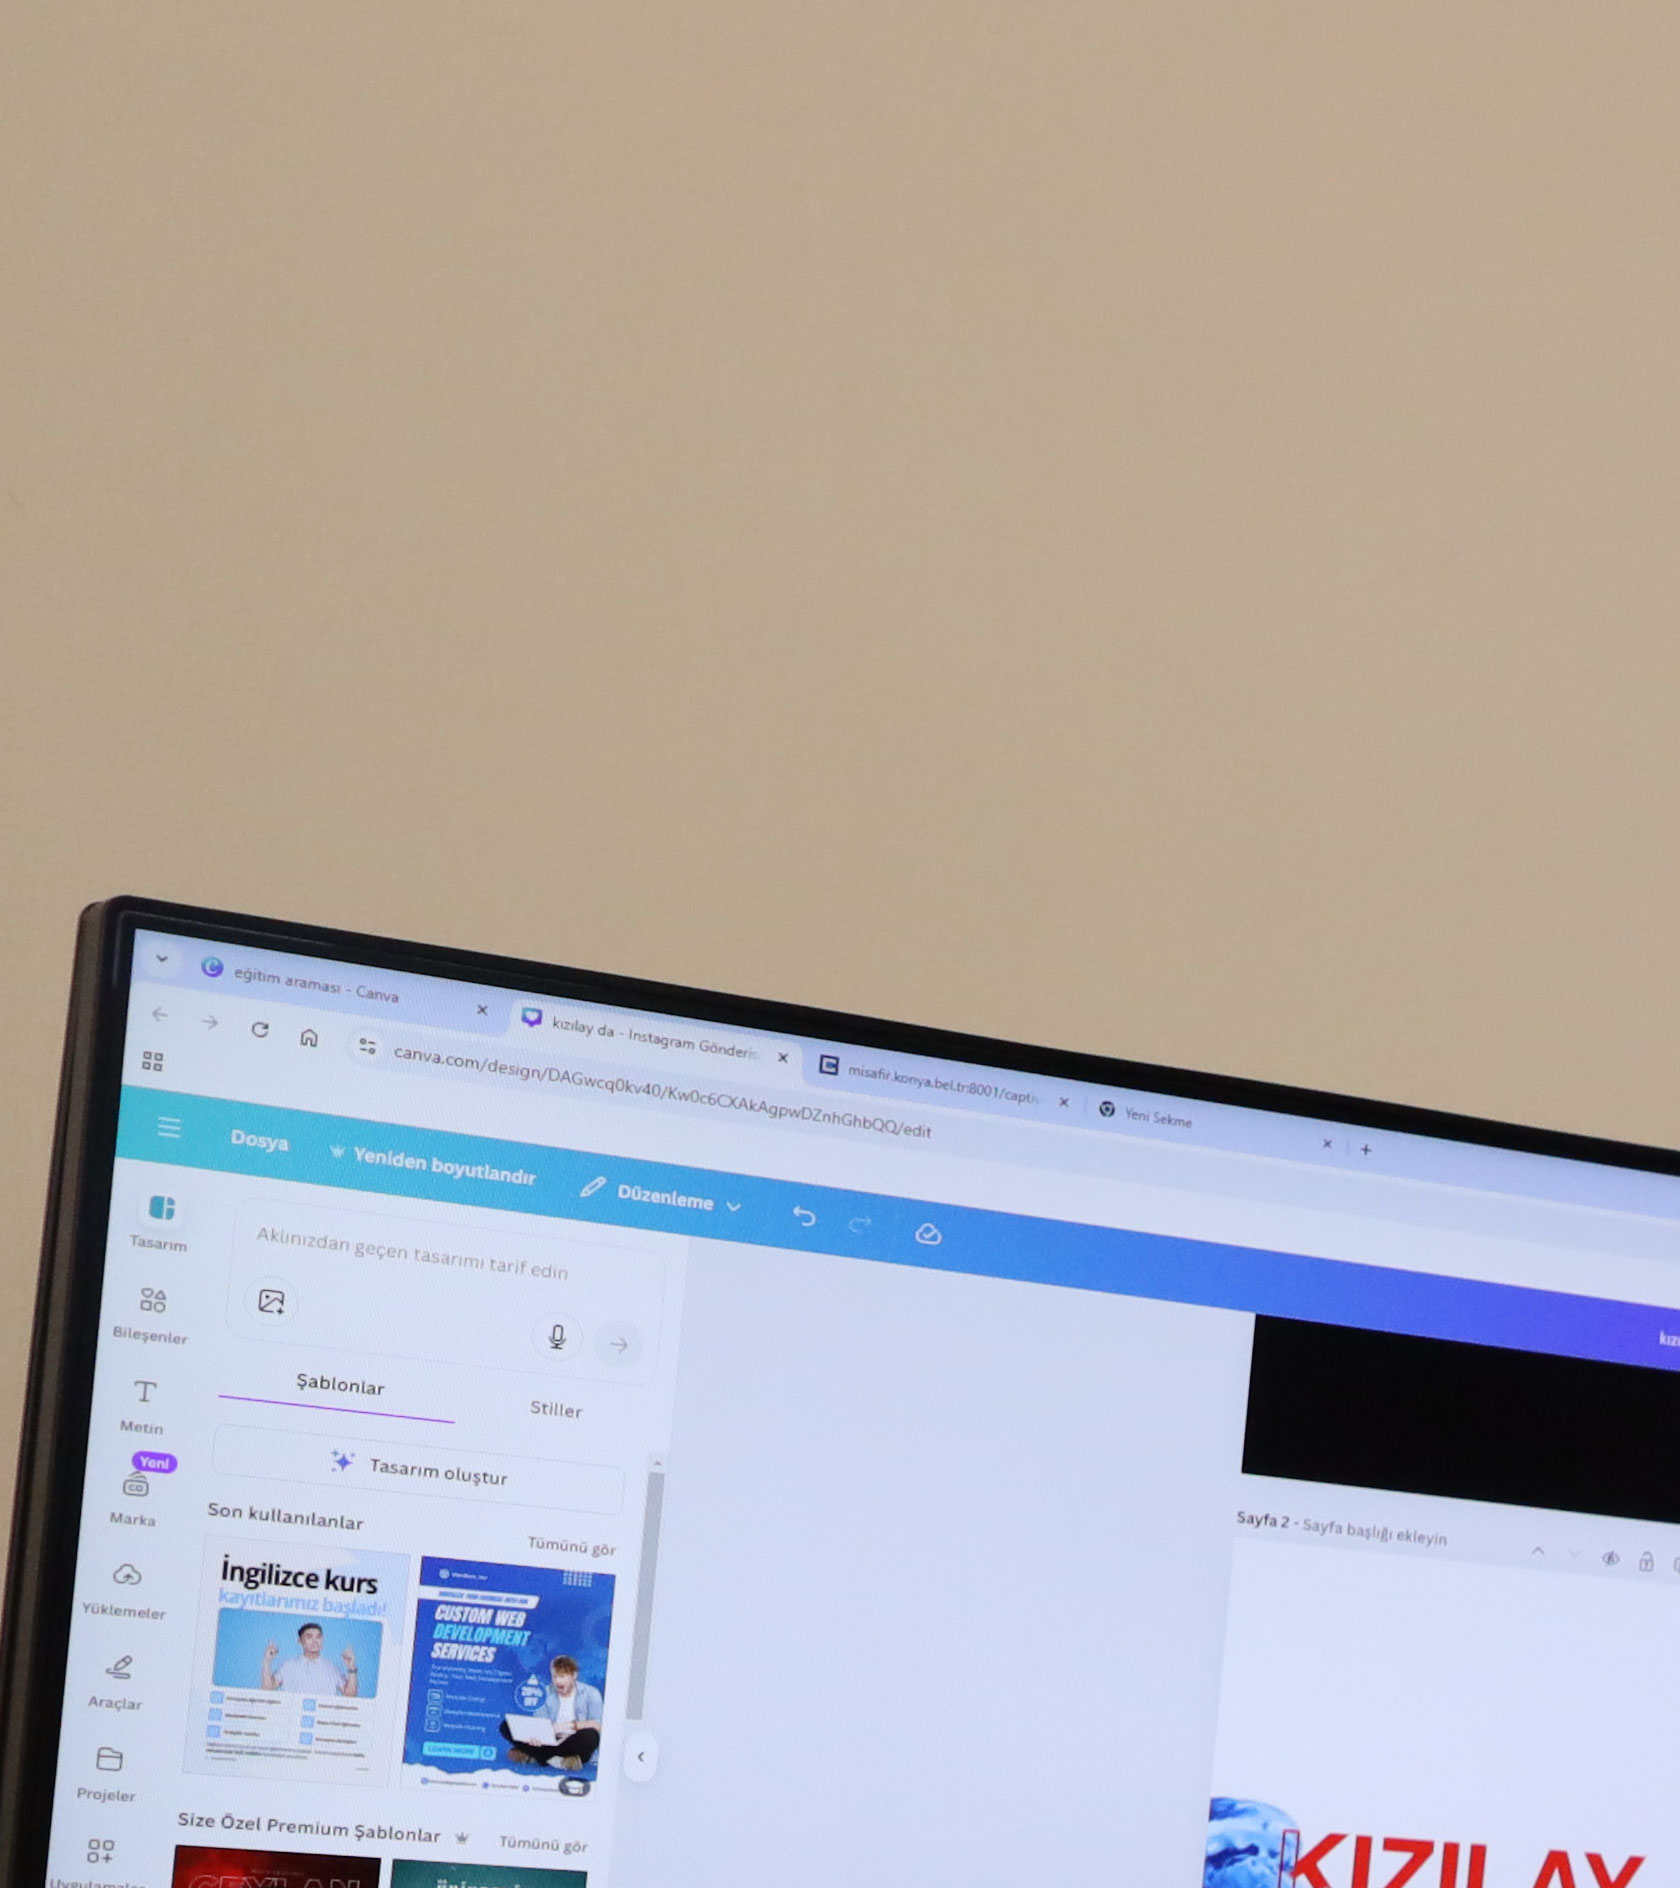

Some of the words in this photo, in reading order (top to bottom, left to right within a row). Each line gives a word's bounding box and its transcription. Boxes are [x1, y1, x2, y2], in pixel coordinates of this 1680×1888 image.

[234, 966, 280, 985] eğitim
[285, 976, 341, 994] araması
[356, 985, 400, 1003] Canva
[552, 1015, 594, 1037] kızılay
[597, 1022, 615, 1037] da
[629, 1028, 695, 1050] Instagram
[1125, 1106, 1150, 1122] Yeni
[1153, 1110, 1193, 1129] Sekme
[230, 1128, 290, 1153] Dosya
[354, 1146, 427, 1171] Yeniden
[432, 1153, 537, 1187] boyutlandır
[618, 1183, 714, 1211] Düzenleme
[129, 1233, 188, 1252] Tasarım
[258, 1226, 350, 1252] Aklınızdan
[355, 1240, 408, 1263] geçen
[414, 1248, 485, 1271] tasarımı
[490, 1255, 528, 1275] tarif
[531, 1260, 569, 1280] edin
[112, 1326, 188, 1346] Bileşenler
[296, 1373, 386, 1396] Şablonlar
[530, 1400, 583, 1419] Stiller
[119, 1419, 164, 1436] Metin
[139, 1455, 170, 1470] Yeni
[370, 1458, 440, 1480] Tasarım
[444, 1465, 508, 1486] oluştur
[109, 1511, 156, 1527] Marka
[207, 1502, 243, 1519] Son
[248, 1506, 364, 1531] kullanılanlar
[1236, 1511, 1278, 1529] Sayfa
[1280, 1515, 1290, 1529] 2
[1303, 1518, 1343, 1536] Sayfa
[1347, 1522, 1393, 1543] başlığı
[1396, 1529, 1448, 1548] ekleyin
[528, 1536, 588, 1553] Tümünü
[592, 1541, 617, 1557] gör
[221, 1554, 319, 1590] İngilizce
[325, 1568, 379, 1594] kurs
[82, 1601, 166, 1620] Yüklemeler
[434, 1604, 494, 1624] CUSTOM
[495, 1609, 527, 1628] WEB
[432, 1623, 532, 1646] DEVELOPMENT
[430, 1642, 497, 1663] SERVICES
[88, 1696, 142, 1712] Araçlar
[77, 1787, 137, 1803] Projeler
[177, 1812, 216, 1829] Size
[221, 1812, 261, 1831] Özel
[267, 1818, 349, 1837] Premium
[354, 1825, 441, 1843] Şablonlar
[500, 1835, 560, 1851] Tümünü
[563, 1840, 588, 1855] gör
